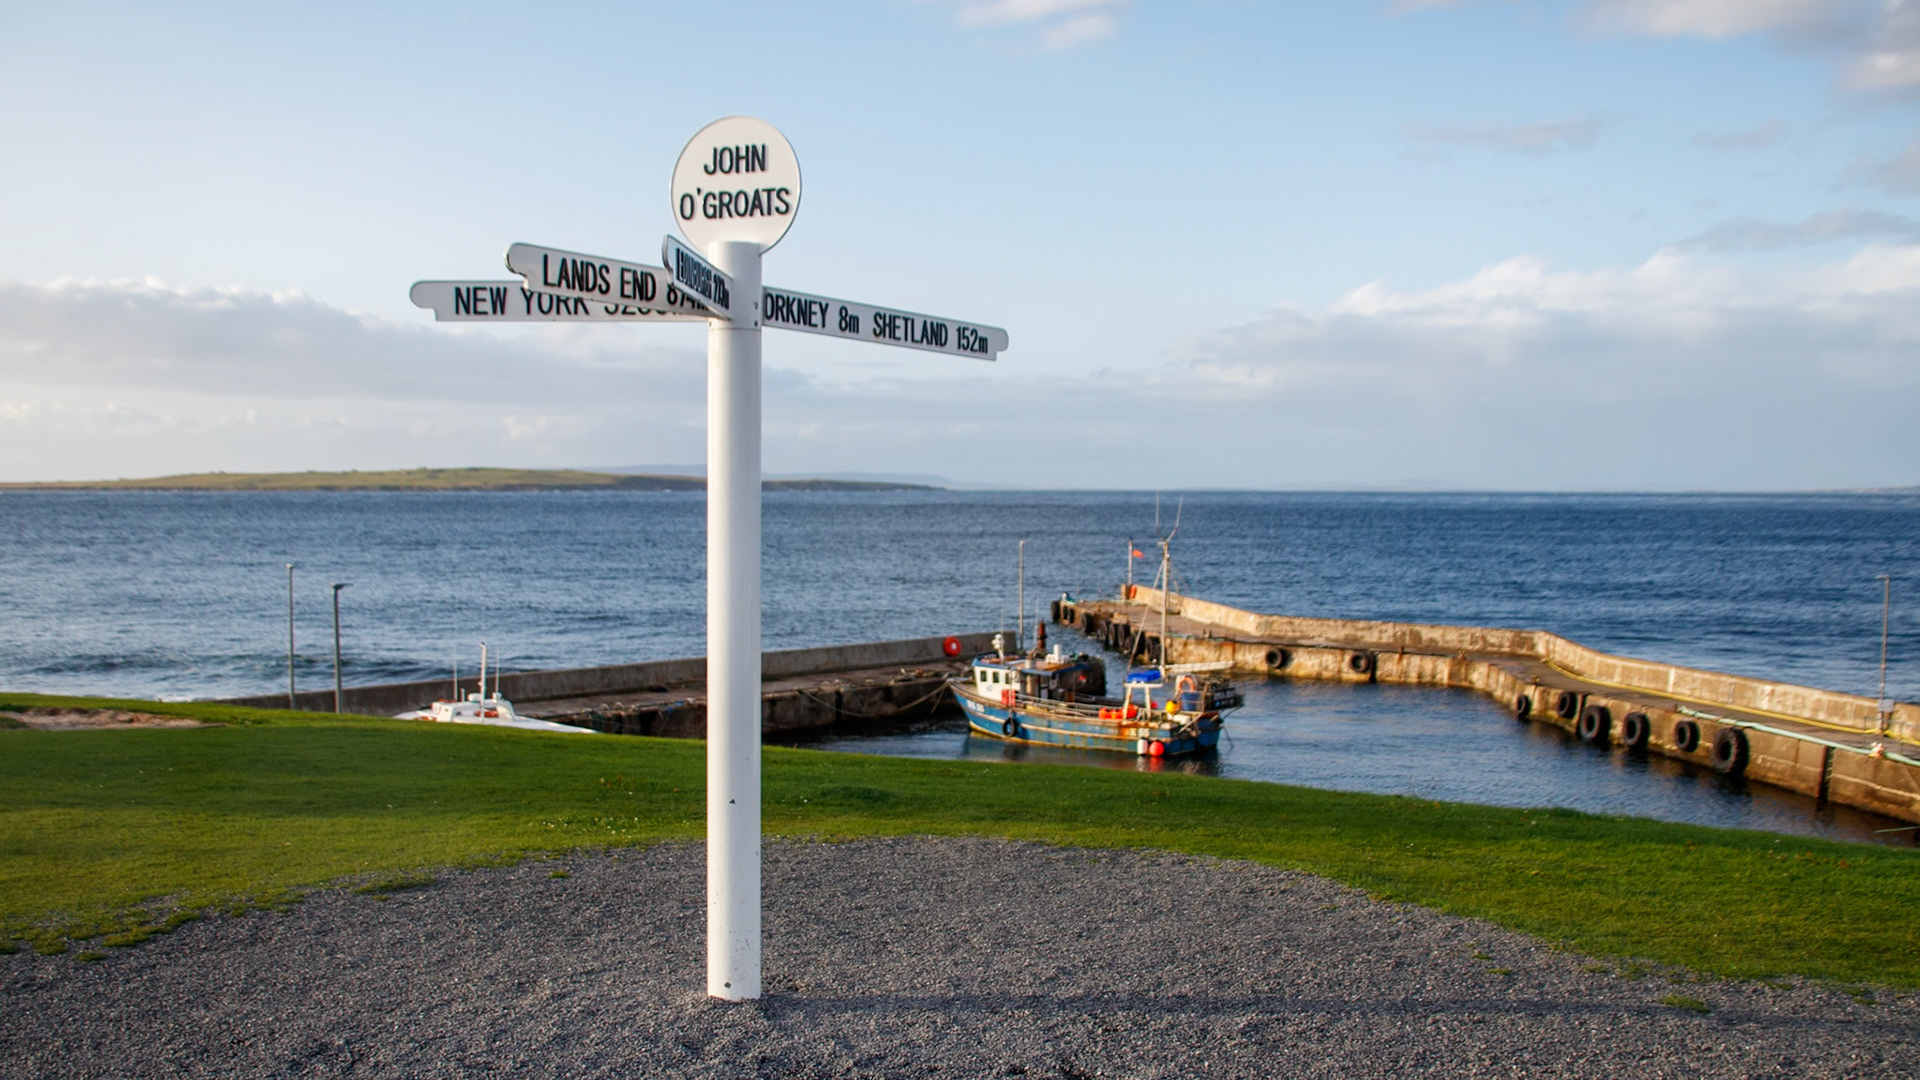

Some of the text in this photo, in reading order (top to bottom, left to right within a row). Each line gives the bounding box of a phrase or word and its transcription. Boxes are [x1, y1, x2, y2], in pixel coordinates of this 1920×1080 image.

[703, 143, 767, 176] JOHN
[680, 187, 789, 220] O'GROATS
[543, 254, 611, 294] LANDS
[619, 266, 657, 302] END
[454, 286, 508, 316] NEW
[764, 291, 988, 354] ORKNEY 8m SHETLAND 152m
